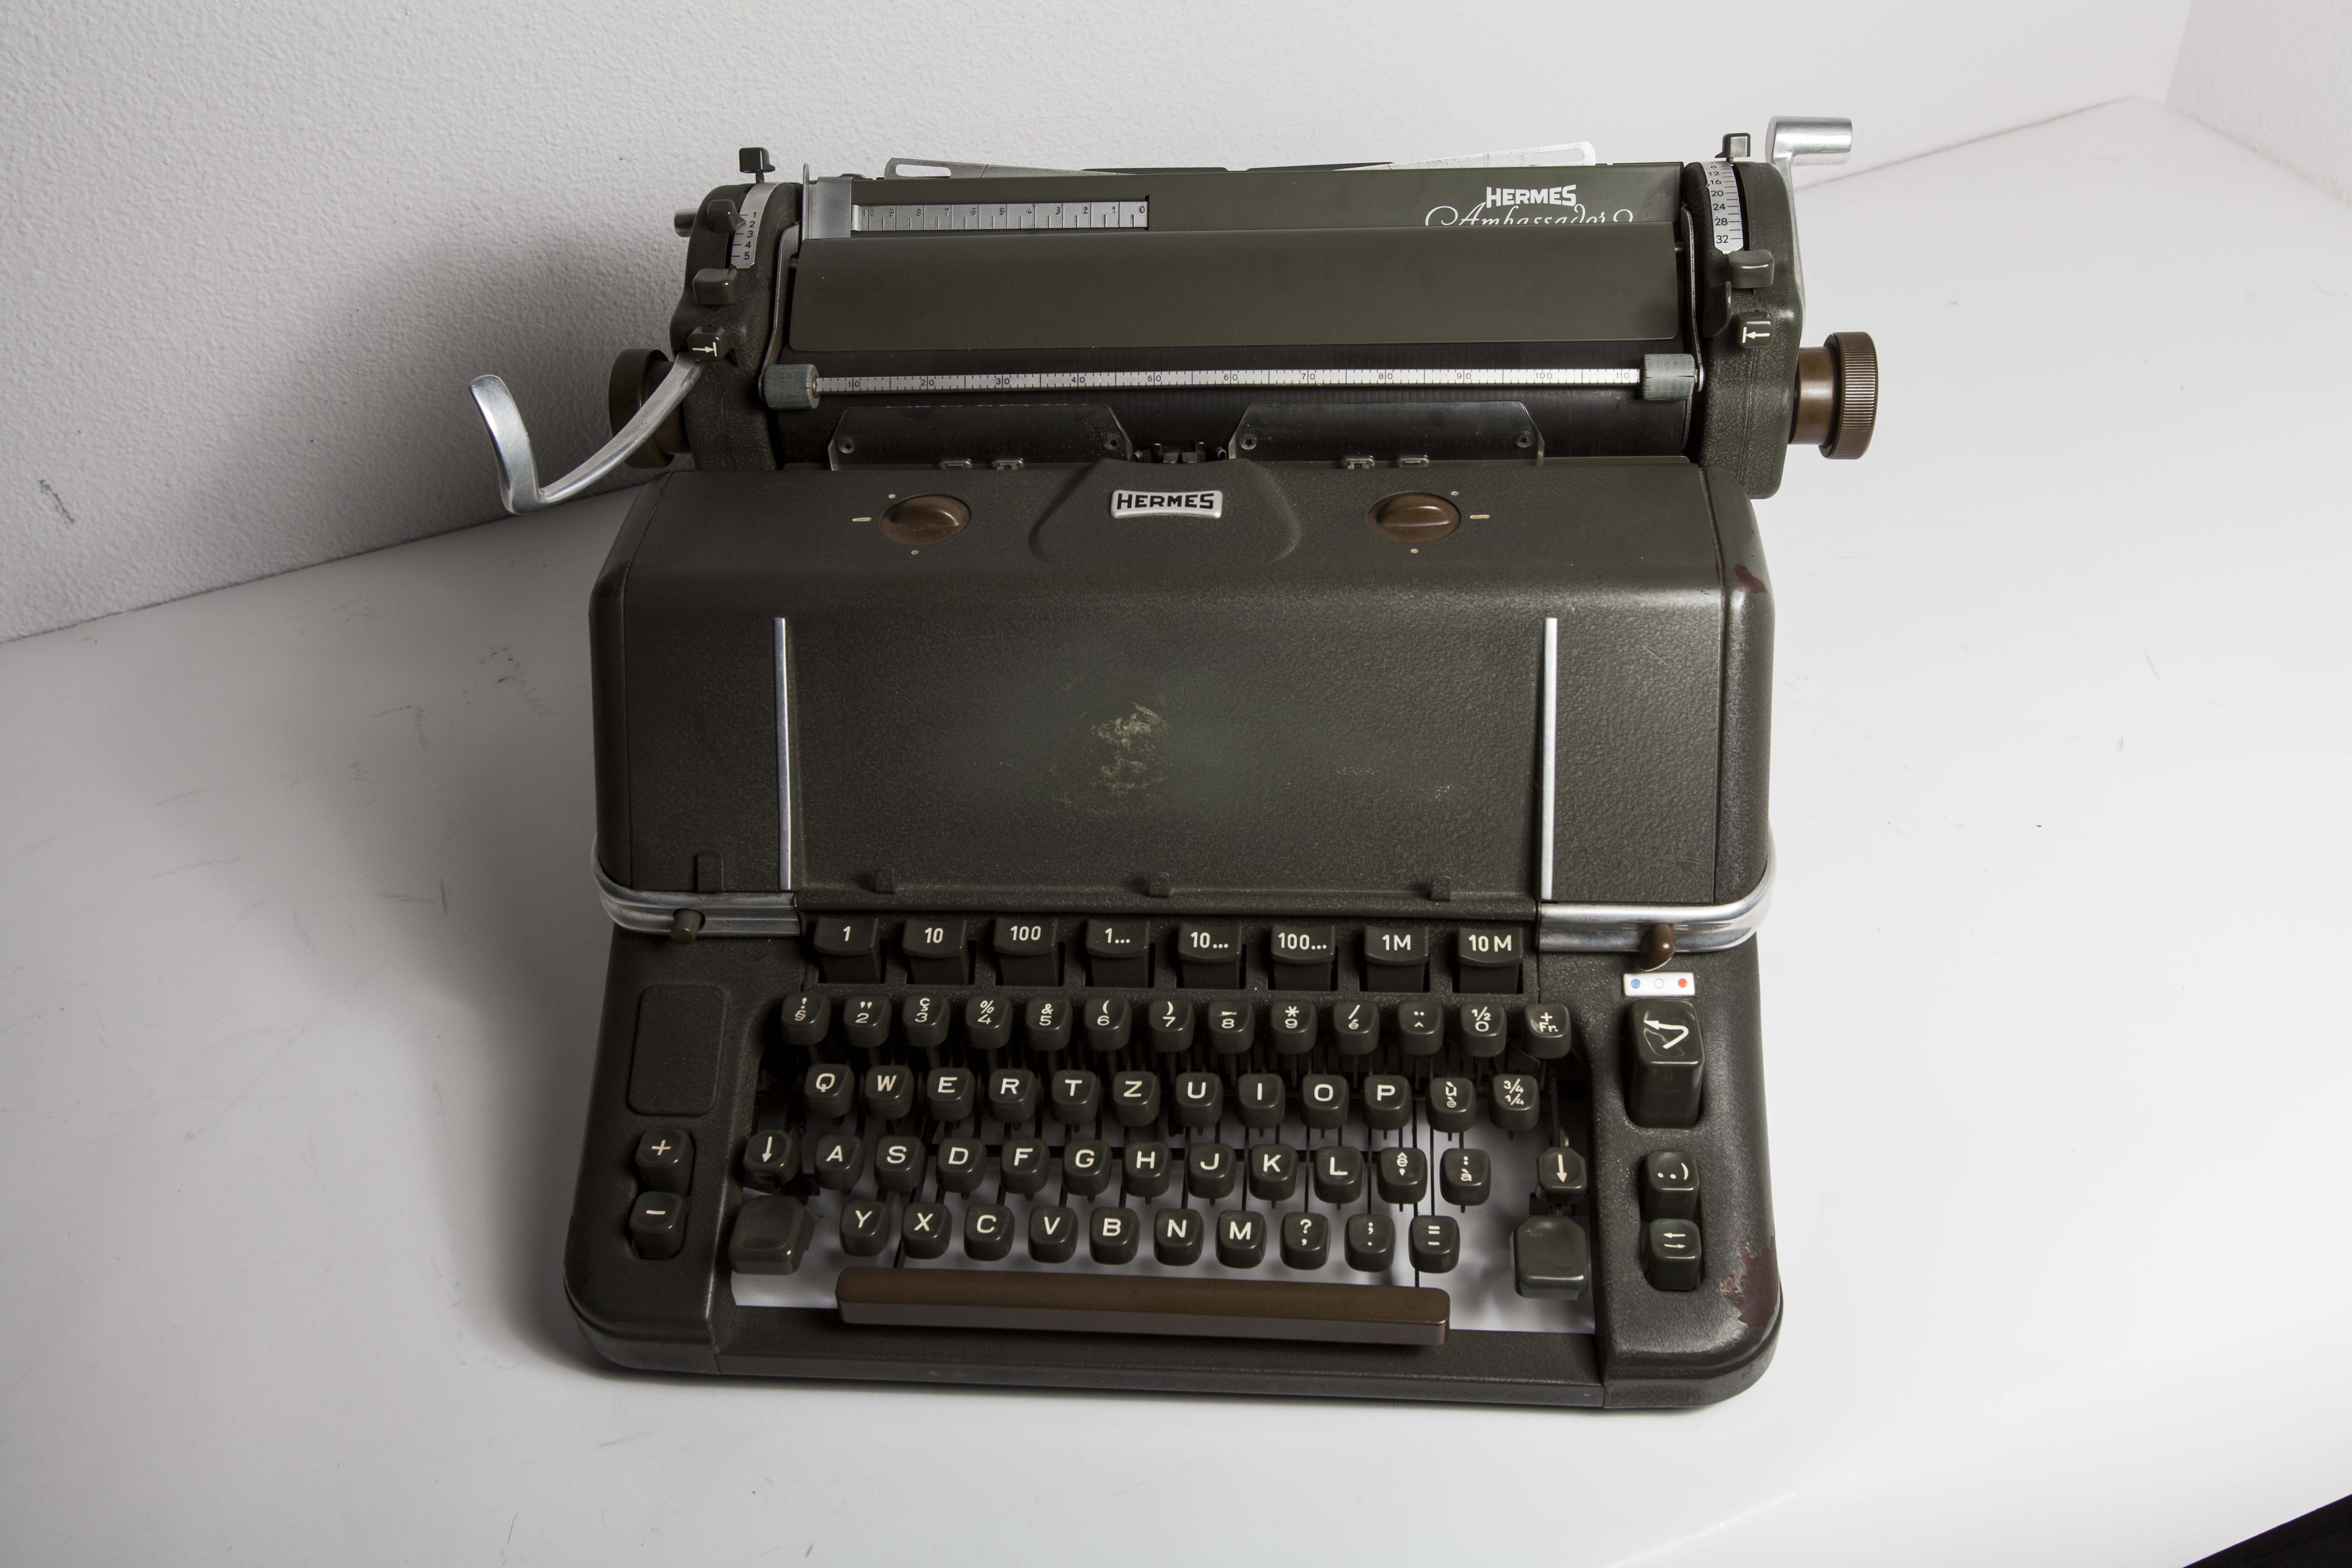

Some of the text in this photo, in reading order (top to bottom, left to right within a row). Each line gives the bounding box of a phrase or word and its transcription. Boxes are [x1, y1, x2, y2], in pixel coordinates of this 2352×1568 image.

[1486, 184, 1576, 209] HERMES
[888, 208, 895, 217] 9
[916, 208, 922, 217] 8
[944, 208, 951, 217] 7
[971, 207, 977, 216] 6
[999, 207, 1006, 216] 5
[1055, 206, 1061, 215] 3
[1139, 205, 1145, 214] 0
[1714, 217, 1728, 226] 28
[1716, 235, 1728, 243] 32
[744, 252, 750, 260] 5
[1117, 493, 1214, 510] HERMES
[843, 926, 851, 941] 1
[925, 927, 944, 943] 10
[1010, 926, 1041, 941] 100
[1041, 1003, 1053, 1014] &
[855, 1013, 869, 1023] 2
[915, 1012, 928, 1022] 3
[977, 1014, 991, 1024] 4
[1039, 1015, 1053, 1027] 5
[1097, 1015, 1110, 1026] 6
[1163, 1016, 1176, 1027] 7
[1221, 1018, 1235, 1029] 8
[1284, 1018, 1298, 1029] 9
[815, 1073, 835, 1092] Q
[877, 1075, 897, 1091] W
[938, 1077, 957, 1093] E
[1001, 1078, 1019, 1094] R
[1065, 1079, 1082, 1096] T
[1123, 1081, 1142, 1097] Z
[1187, 1081, 1206, 1099] U
[1257, 1083, 1262, 1100] I
[1314, 1083, 1333, 1101] O
[1377, 1084, 1395, 1101] P
[826, 1145, 843, 1162] A
[887, 1145, 907, 1164] S
[948, 1147, 969, 1165] D
[1014, 1148, 1033, 1166] F
[1075, 1149, 1095, 1168] G
[1136, 1151, 1155, 1169] H
[1200, 1153, 1219, 1170] J
[1263, 1154, 1281, 1172] K
[1330, 1156, 1348, 1176] L
[855, 1210, 872, 1228] Y
[914, 1212, 933, 1231] X
[977, 1215, 996, 1233] C
[1044, 1216, 1060, 1235] V
[1102, 1218, 1121, 1236] B
[1167, 1219, 1187, 1238] N
[1229, 1221, 1251, 1240] M
